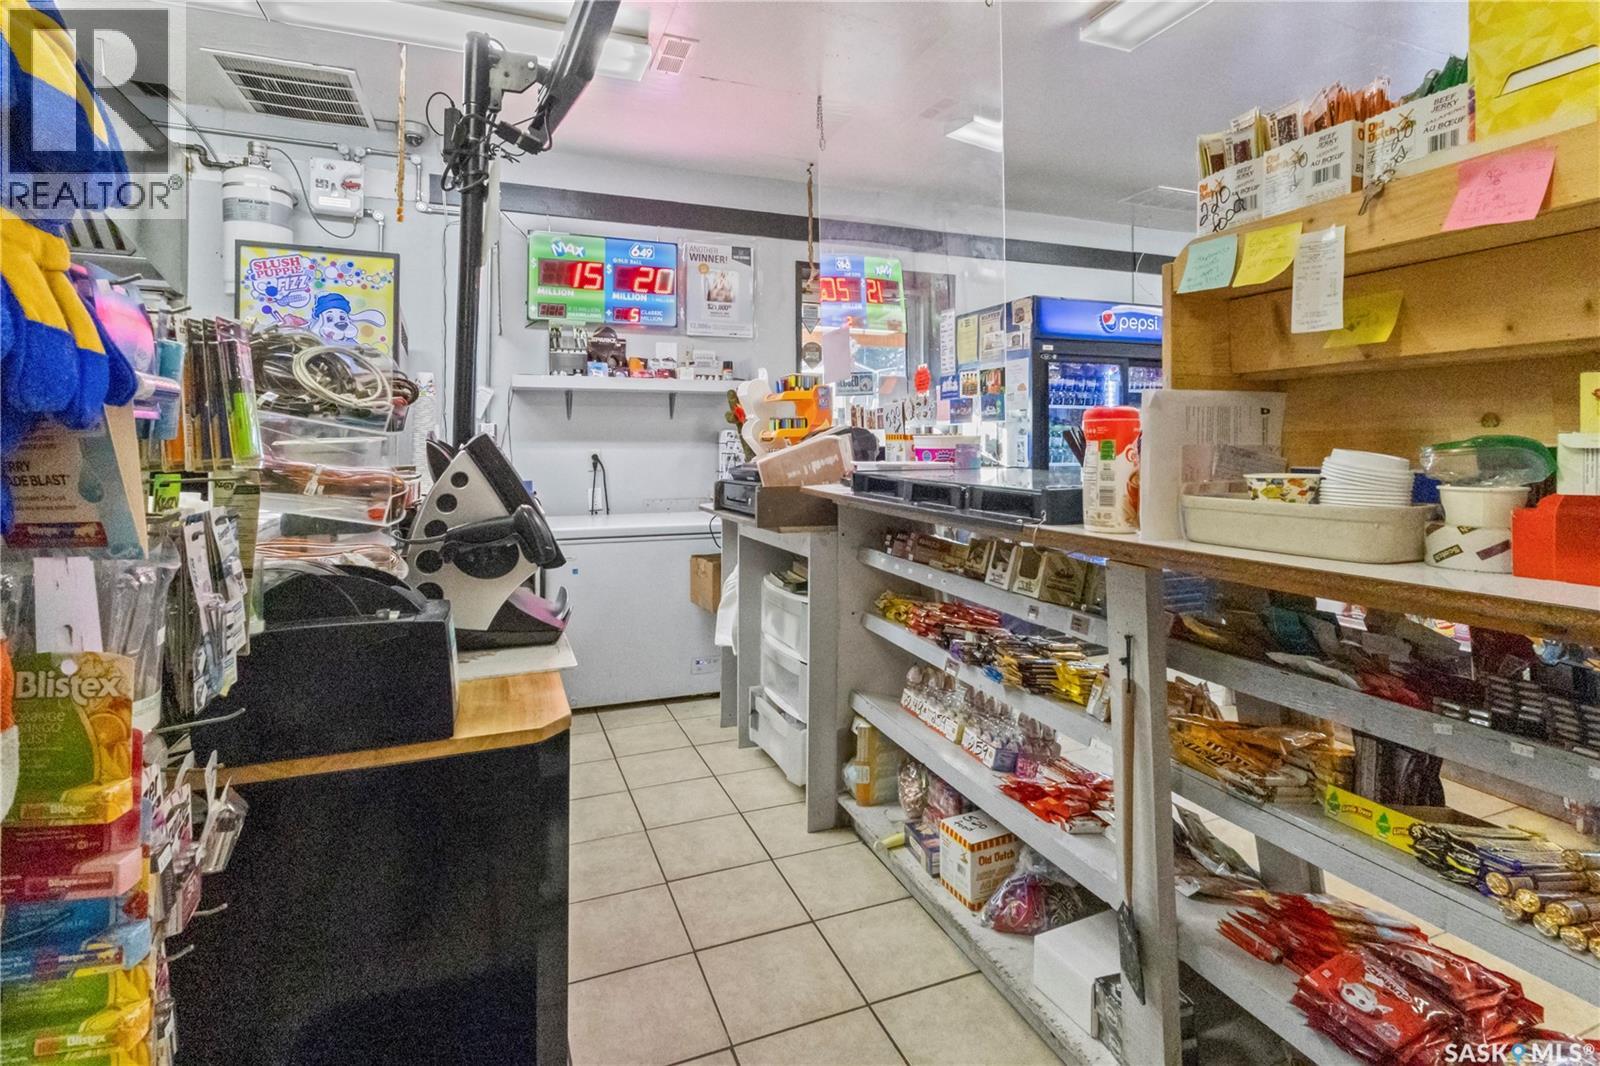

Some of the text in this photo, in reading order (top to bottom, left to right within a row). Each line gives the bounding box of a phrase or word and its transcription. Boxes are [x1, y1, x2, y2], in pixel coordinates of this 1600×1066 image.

[1431, 98, 1460, 113] JERKY
[1434, 93, 1456, 105] BEEF
[1423, 126, 1436, 134] AU
[551, 240, 585, 257] MAX
[690, 246, 718, 255] ANOTHER
[253, 256, 301, 270] SLUSH
[689, 252, 728, 264] WINNER!
[256, 266, 302, 278] PUPPIE
[573, 262, 603, 289] 15
[278, 275, 308, 292] FIZZ
[632, 266, 675, 294] 20
[537, 287, 575, 297] MILLION
[612, 292, 648, 302] MILLION
[1119, 316, 1158, 333] pepsi
[16, 671, 122, 706] Blistex
[50, 804, 87, 816] Blistex
[1342, 805, 1372, 818] Little Trees
[978, 849, 1016, 866] Old Dutch
[67, 1034, 107, 1046] Blistex
